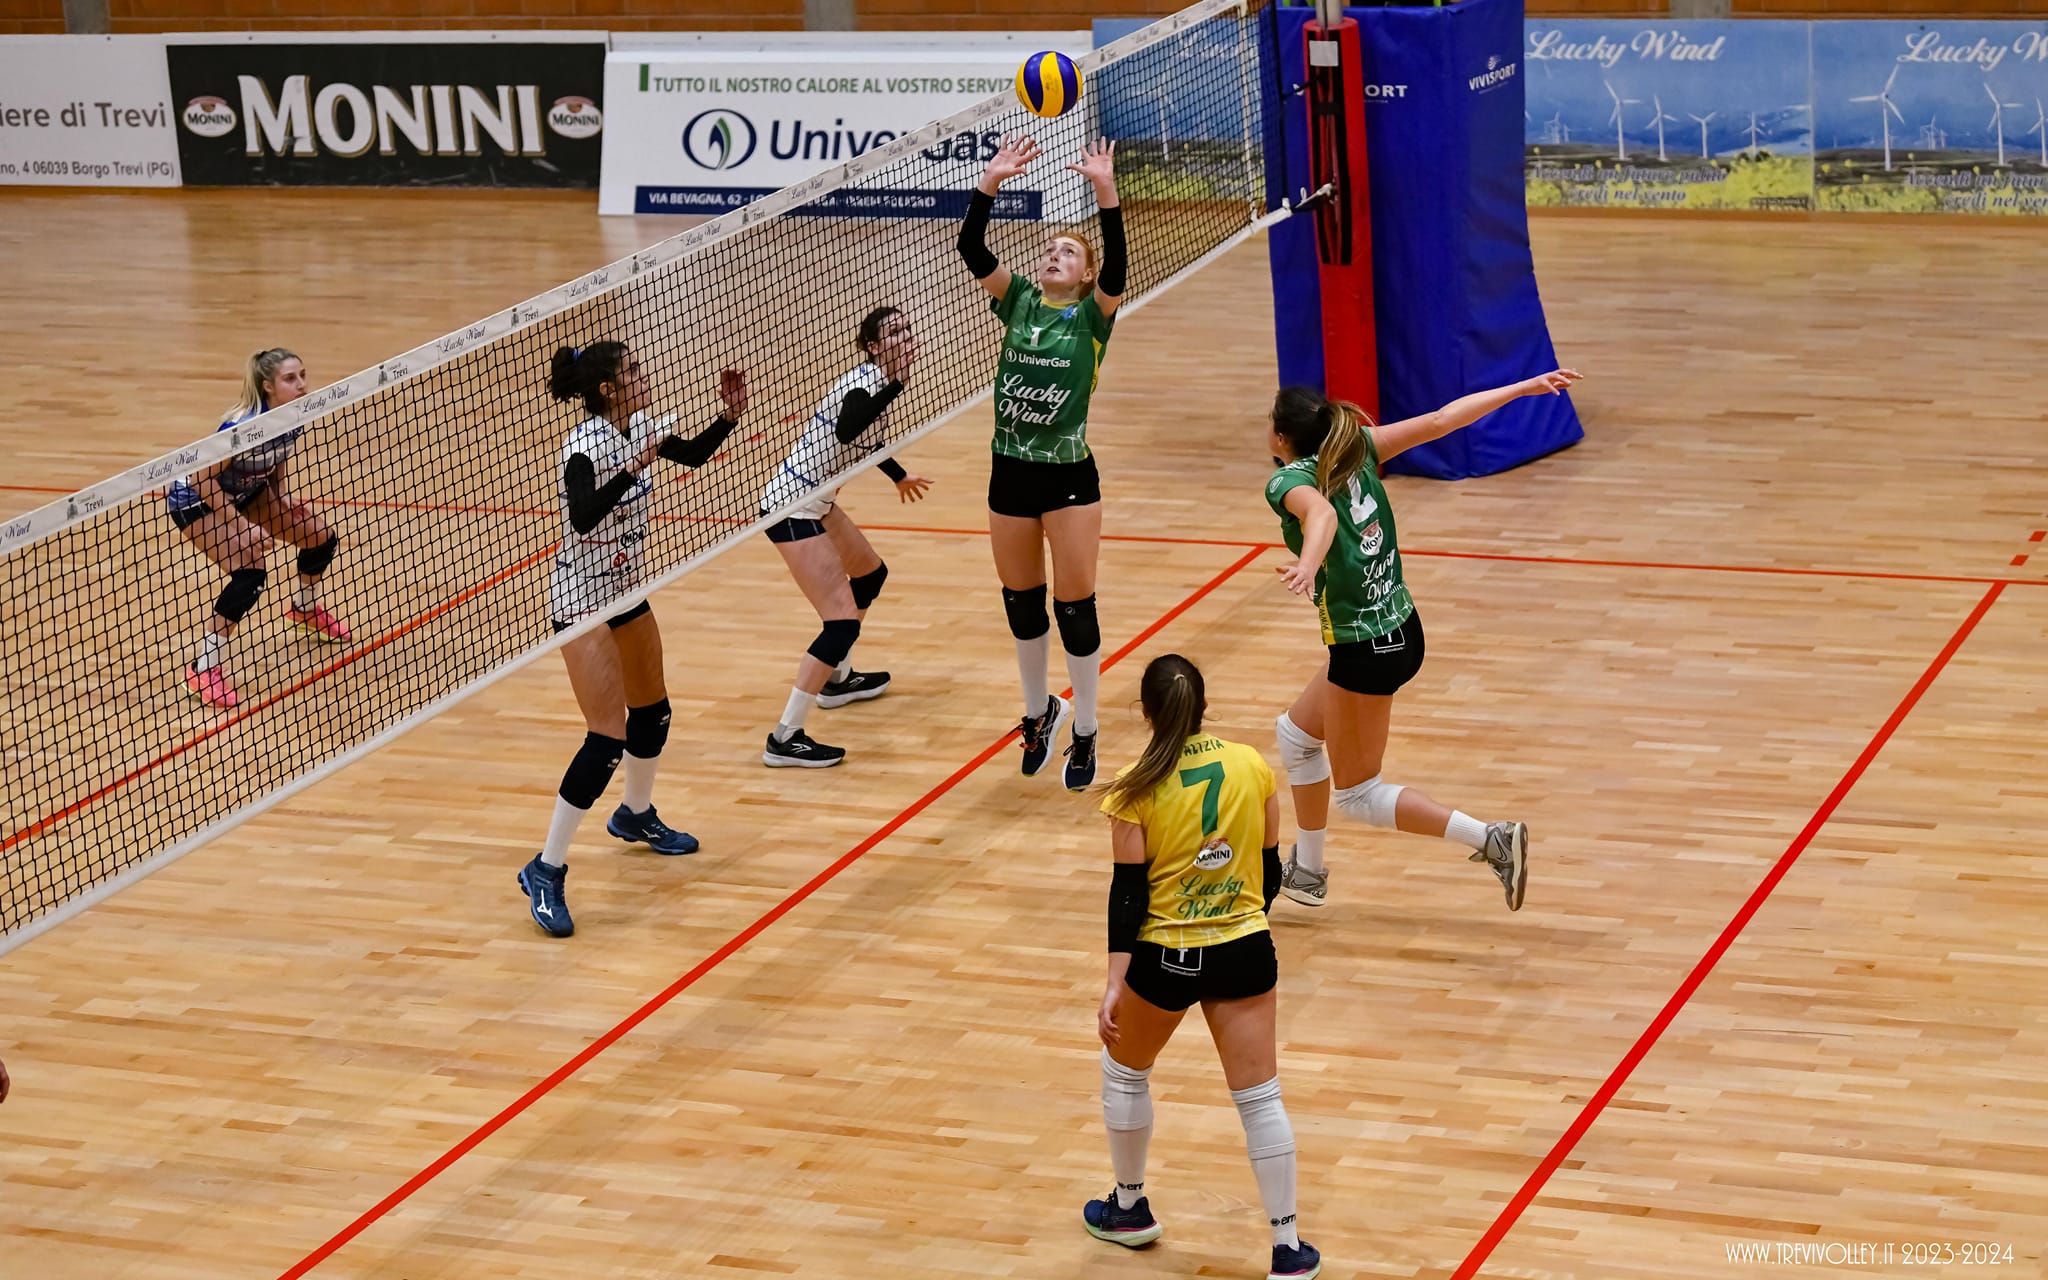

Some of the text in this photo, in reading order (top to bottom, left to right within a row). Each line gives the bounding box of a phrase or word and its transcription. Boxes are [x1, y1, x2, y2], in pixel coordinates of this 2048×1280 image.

[1525, 30, 1726, 68] Lucky Wind
[1896, 31, 2008, 71] Lucky
[654, 77, 1014, 93] TUTTO IL NOSTRO CALORE AL VOSTRO SERVIZ
[1469, 63, 1516, 90] VIVISPORT
[61, 102, 87, 127] di
[94, 102, 167, 127] Trevi
[188, 112, 233, 126] MONINI
[237, 75, 545, 157] MONINI
[552, 111, 599, 126] MONINI
[22, 163, 30, 174] 4
[33, 161, 69, 175] 06039
[73, 161, 110, 179] Borgo
[113, 161, 144, 175] Trevi
[147, 162, 175, 178] (PG)
[649, 193, 669, 204] VIA
[670, 193, 725, 206] BEVAGNA,
[727, 194, 742, 205] 62
[1019, 353, 1071, 368] UniverGas
[301, 384, 349, 414] Lucky Wind
[1000, 372, 1071, 410] Lucky
[999, 398, 1059, 426] Wind
[247, 430, 264, 444] Trevi
[146, 448, 199, 481] Lucky Wind
[85, 497, 104, 513] Trevi
[4, 520, 31, 540] Wind
[1179, 761, 1225, 837] 7
[1196, 849, 1231, 866] MONINI
[1174, 874, 1244, 899] Lucky
[1177, 897, 1235, 919] Wind
